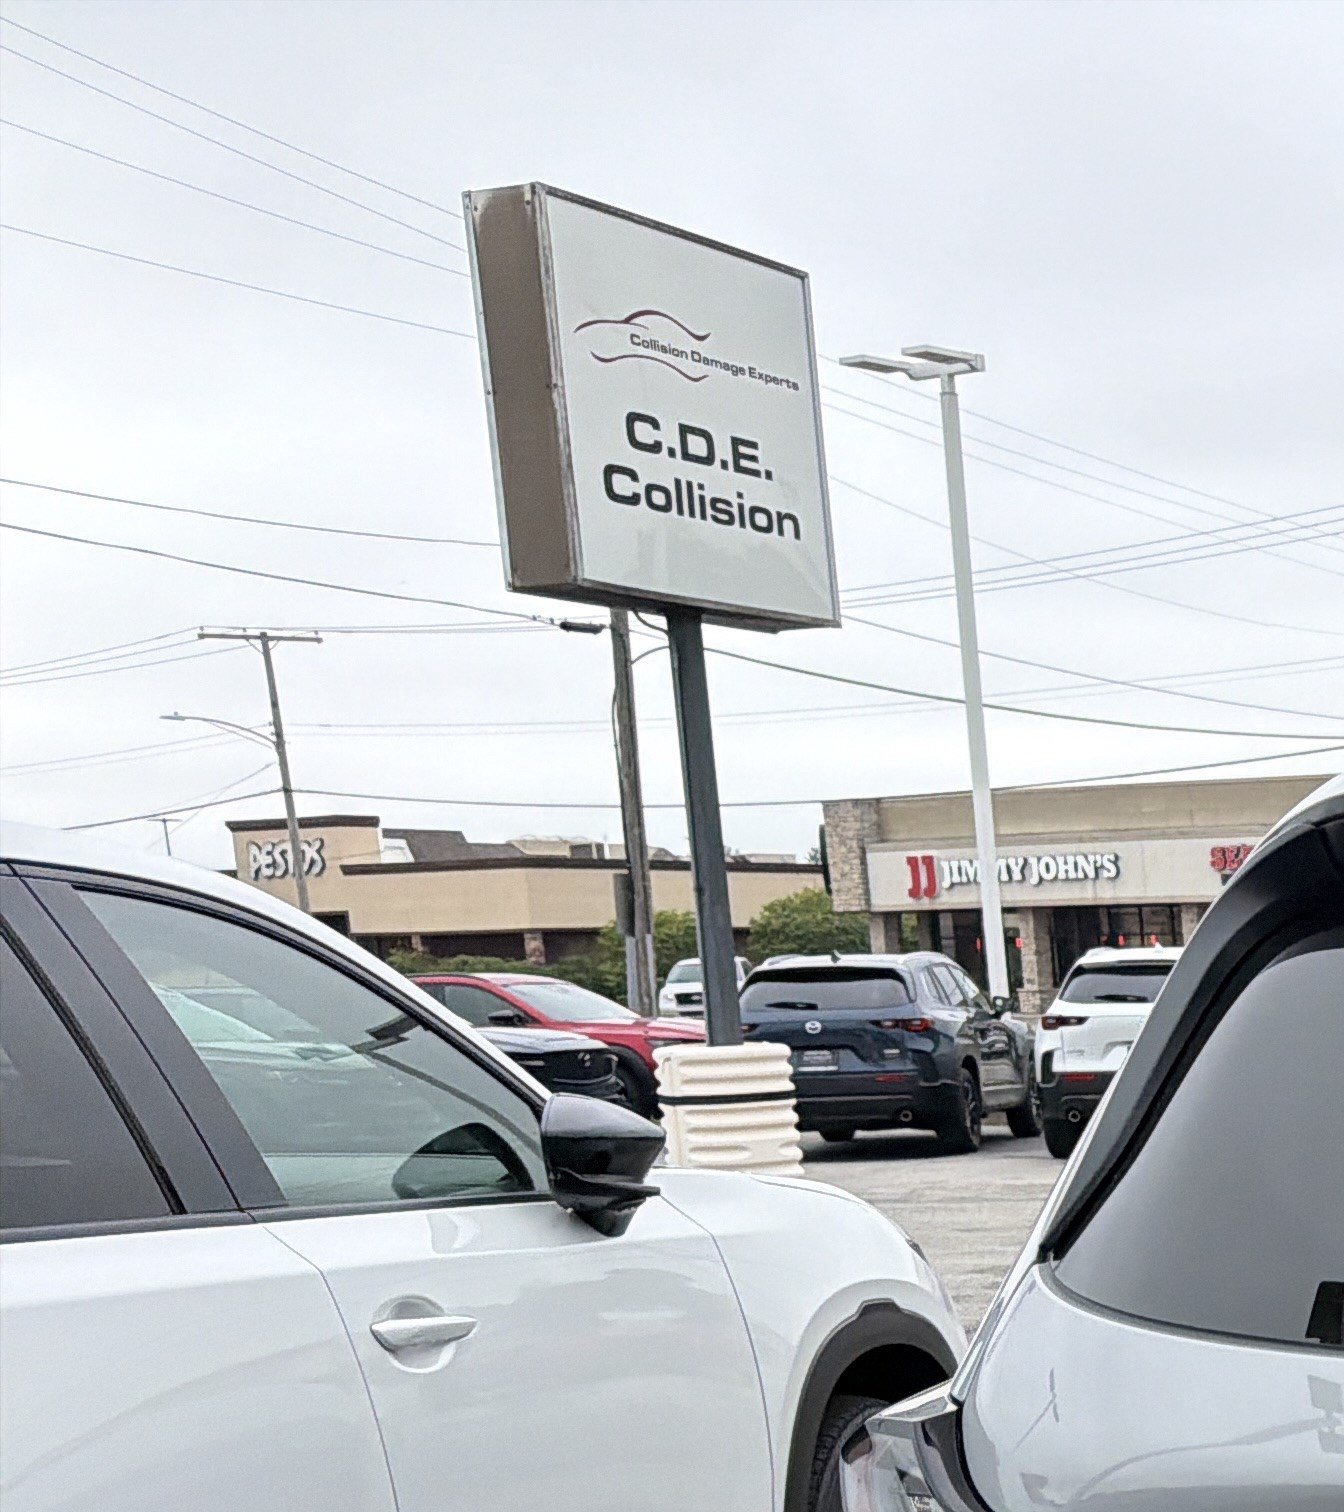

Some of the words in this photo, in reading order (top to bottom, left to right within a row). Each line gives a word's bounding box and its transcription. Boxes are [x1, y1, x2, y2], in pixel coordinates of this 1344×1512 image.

[630, 333, 689, 360] Collision
[690, 349, 747, 377] Damage
[747, 366, 800, 392] Experts
[626, 412, 773, 481] C.D.E.
[603, 464, 801, 541] Collision
[1029, 853, 1120, 886] JOHN'S
